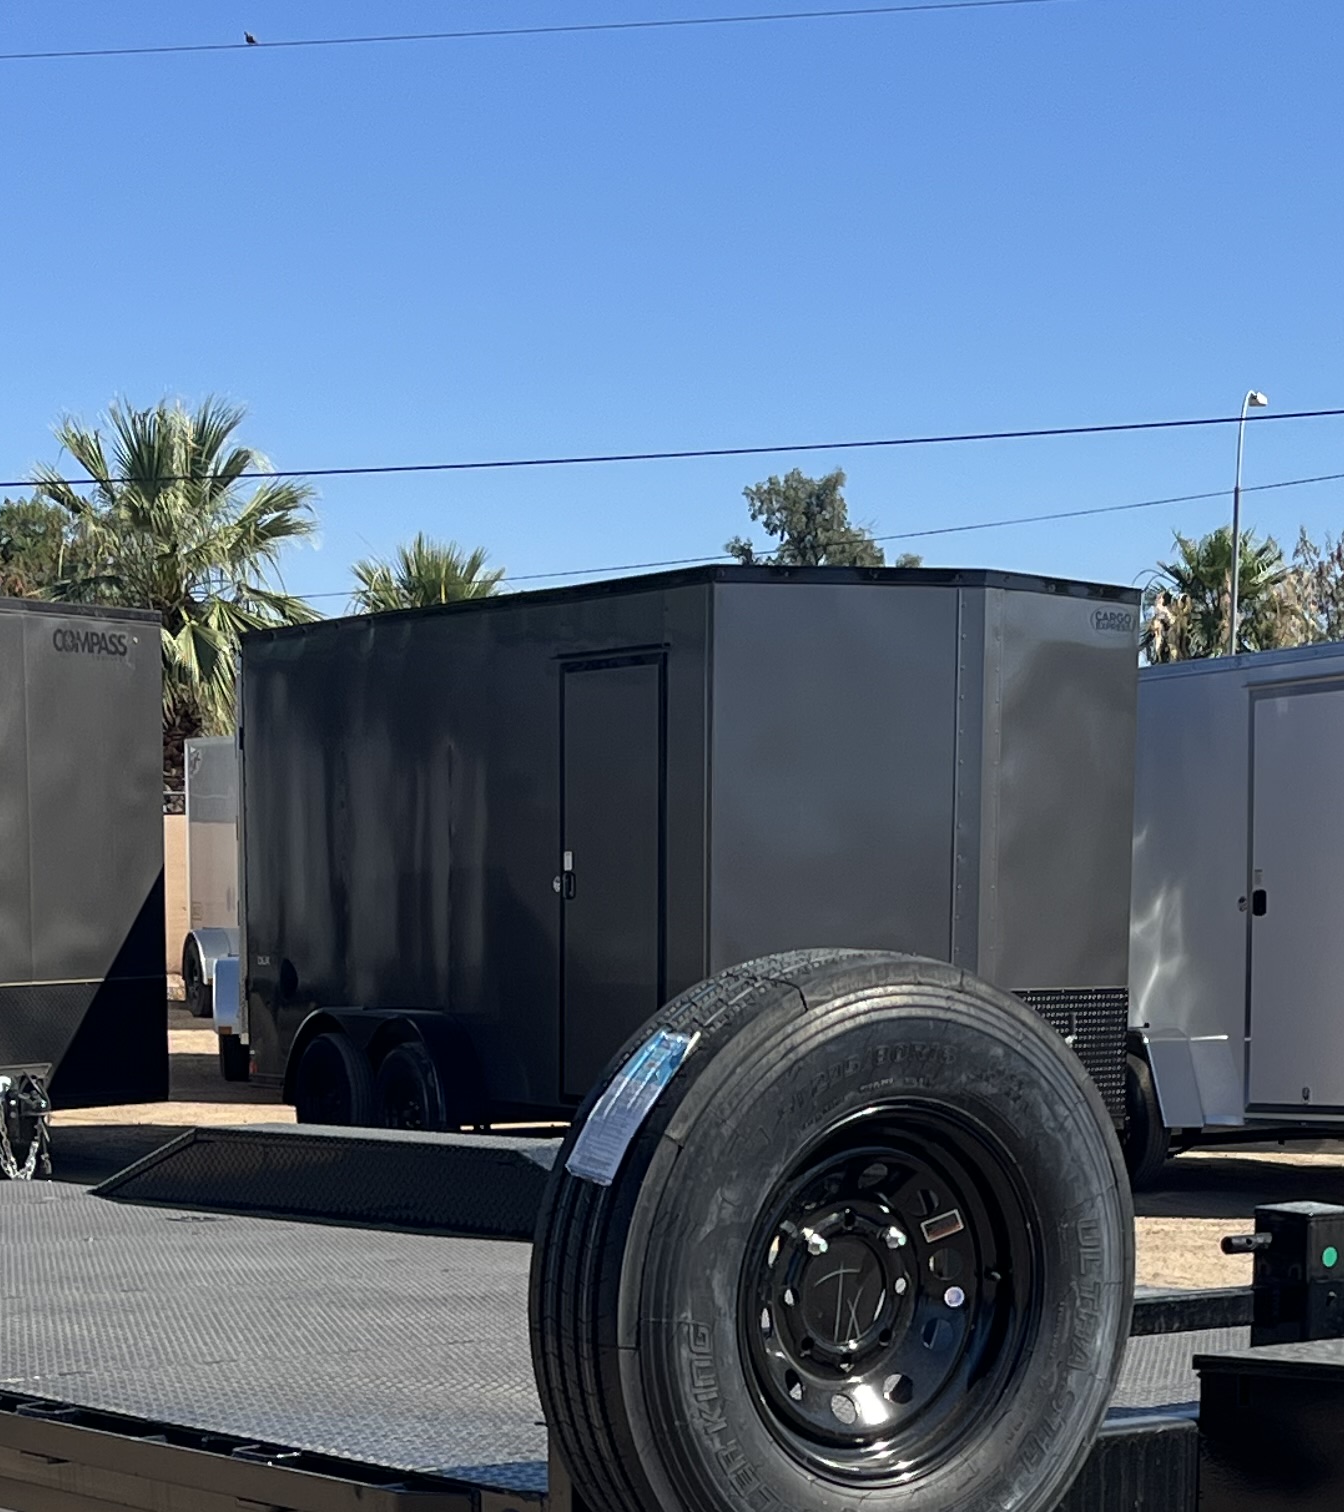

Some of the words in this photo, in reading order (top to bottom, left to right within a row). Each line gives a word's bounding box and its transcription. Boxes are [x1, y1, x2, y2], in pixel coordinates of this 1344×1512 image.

[1095, 611, 1132, 624] CARGO
[53, 629, 128, 657] COMPASS
[686, 1320, 728, 1436] KING
